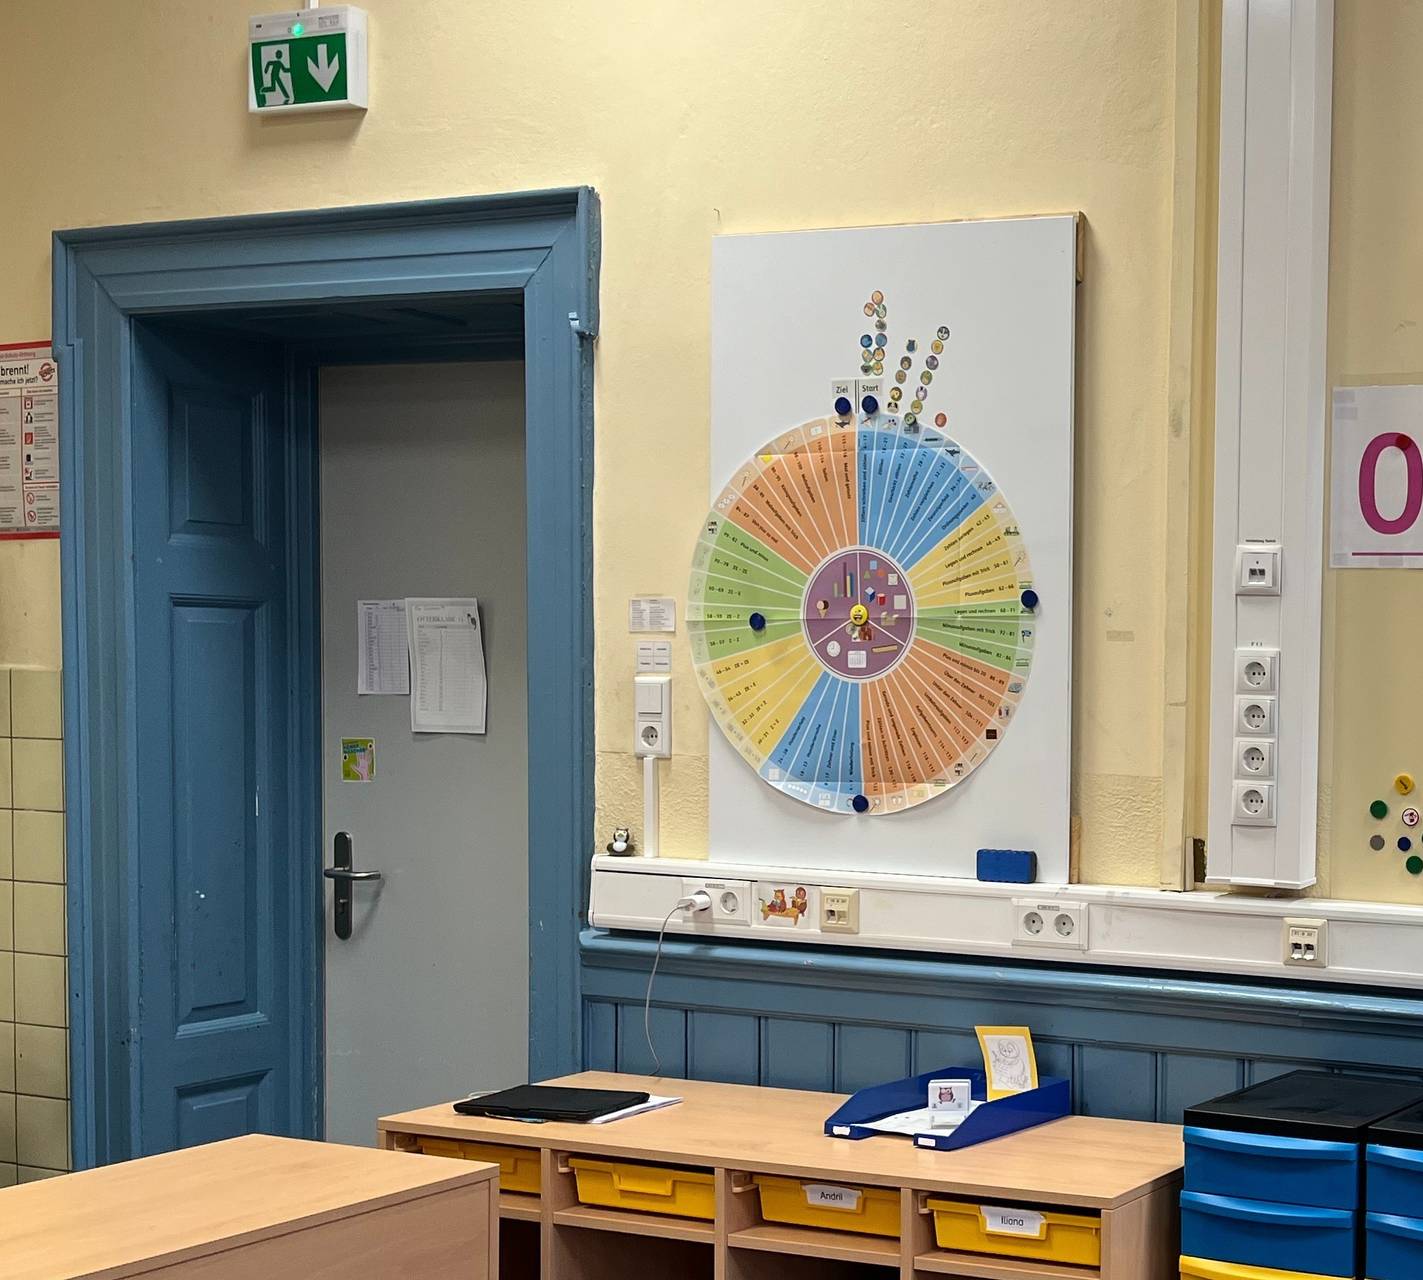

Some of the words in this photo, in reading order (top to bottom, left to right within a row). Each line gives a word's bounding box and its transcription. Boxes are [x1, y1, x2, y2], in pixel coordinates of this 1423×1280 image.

[1, 363, 30, 376] brennt!
[836, 386, 848, 394] Ziel
[862, 384, 879, 393] Start
[1359, 432, 1423, 534] 0
